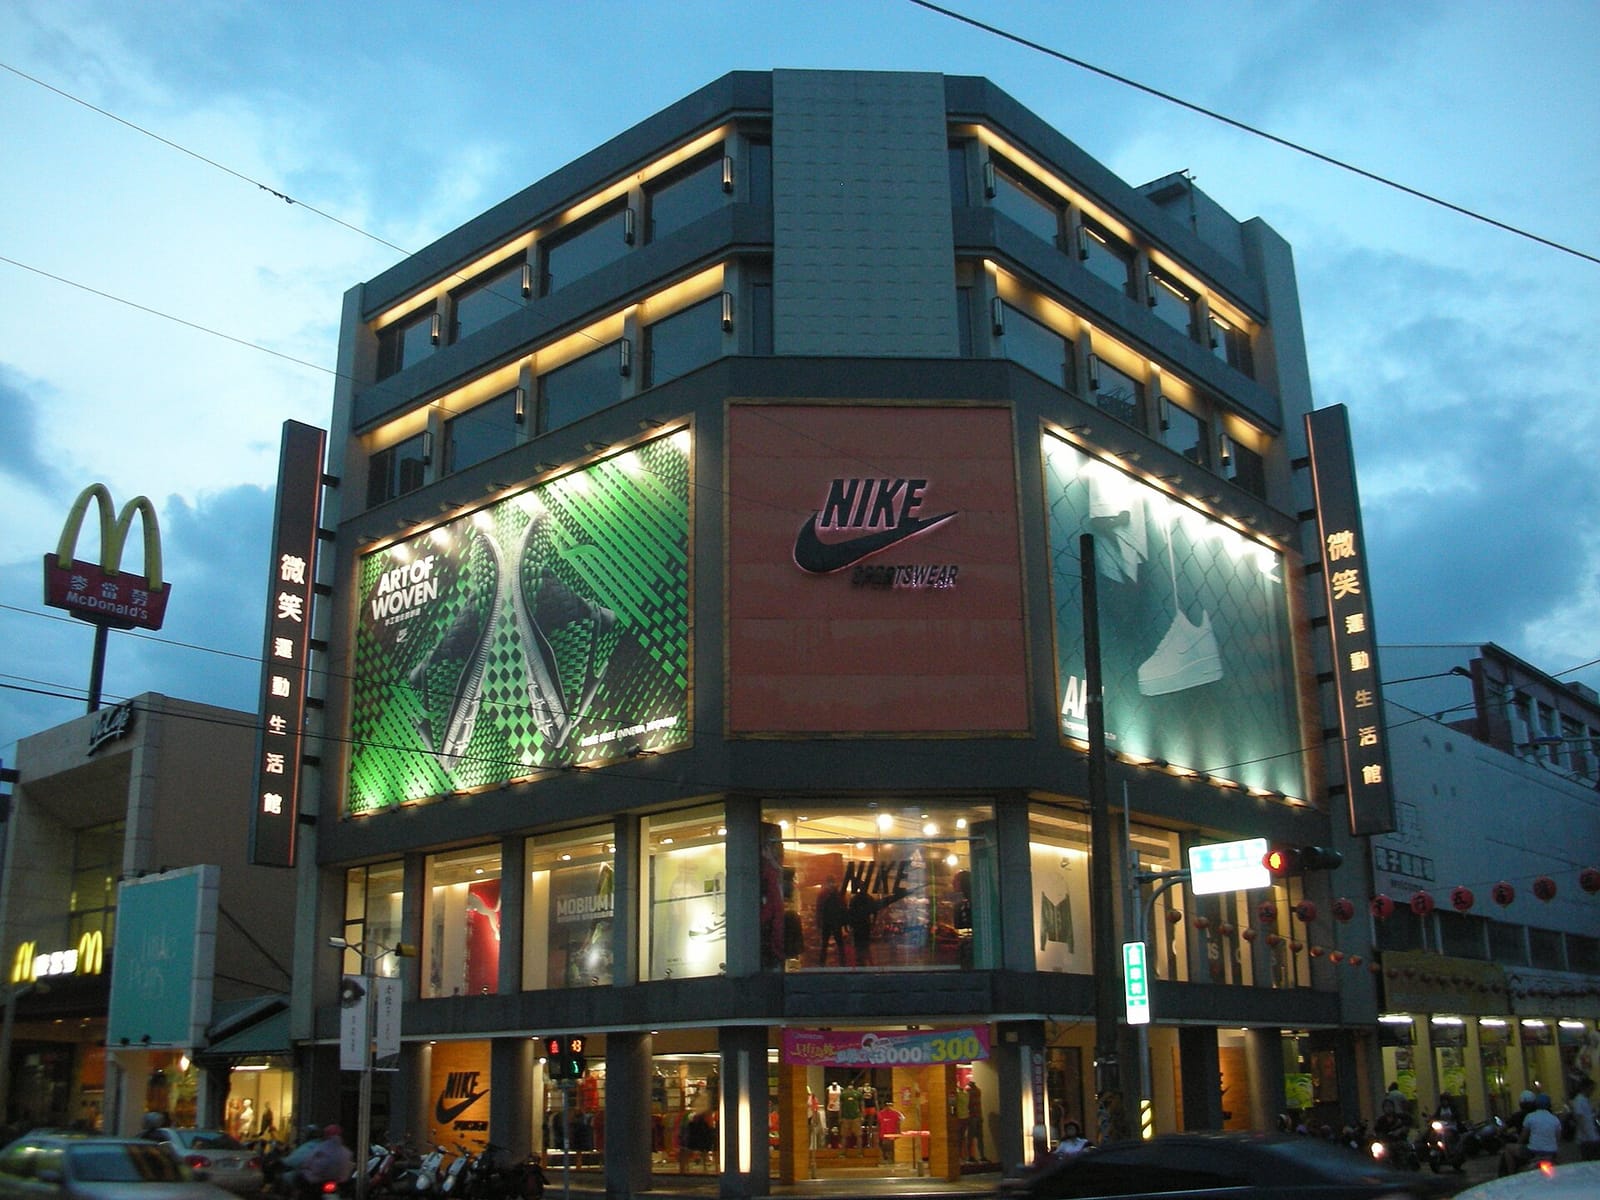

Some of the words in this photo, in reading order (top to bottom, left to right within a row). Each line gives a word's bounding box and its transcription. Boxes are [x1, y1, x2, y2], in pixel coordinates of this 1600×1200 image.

[820, 479, 927, 528] NIKE
[377, 565, 411, 597] ART
[409, 555, 435, 584] OF
[66, 591, 149, 619] McDonald's
[372, 577, 438, 621] WOVEN
[841, 860, 910, 895] NIKE
[557, 894, 609, 917] MOBIUM
[930, 1036, 980, 1061] 300
[444, 1071, 481, 1099] NIKE
